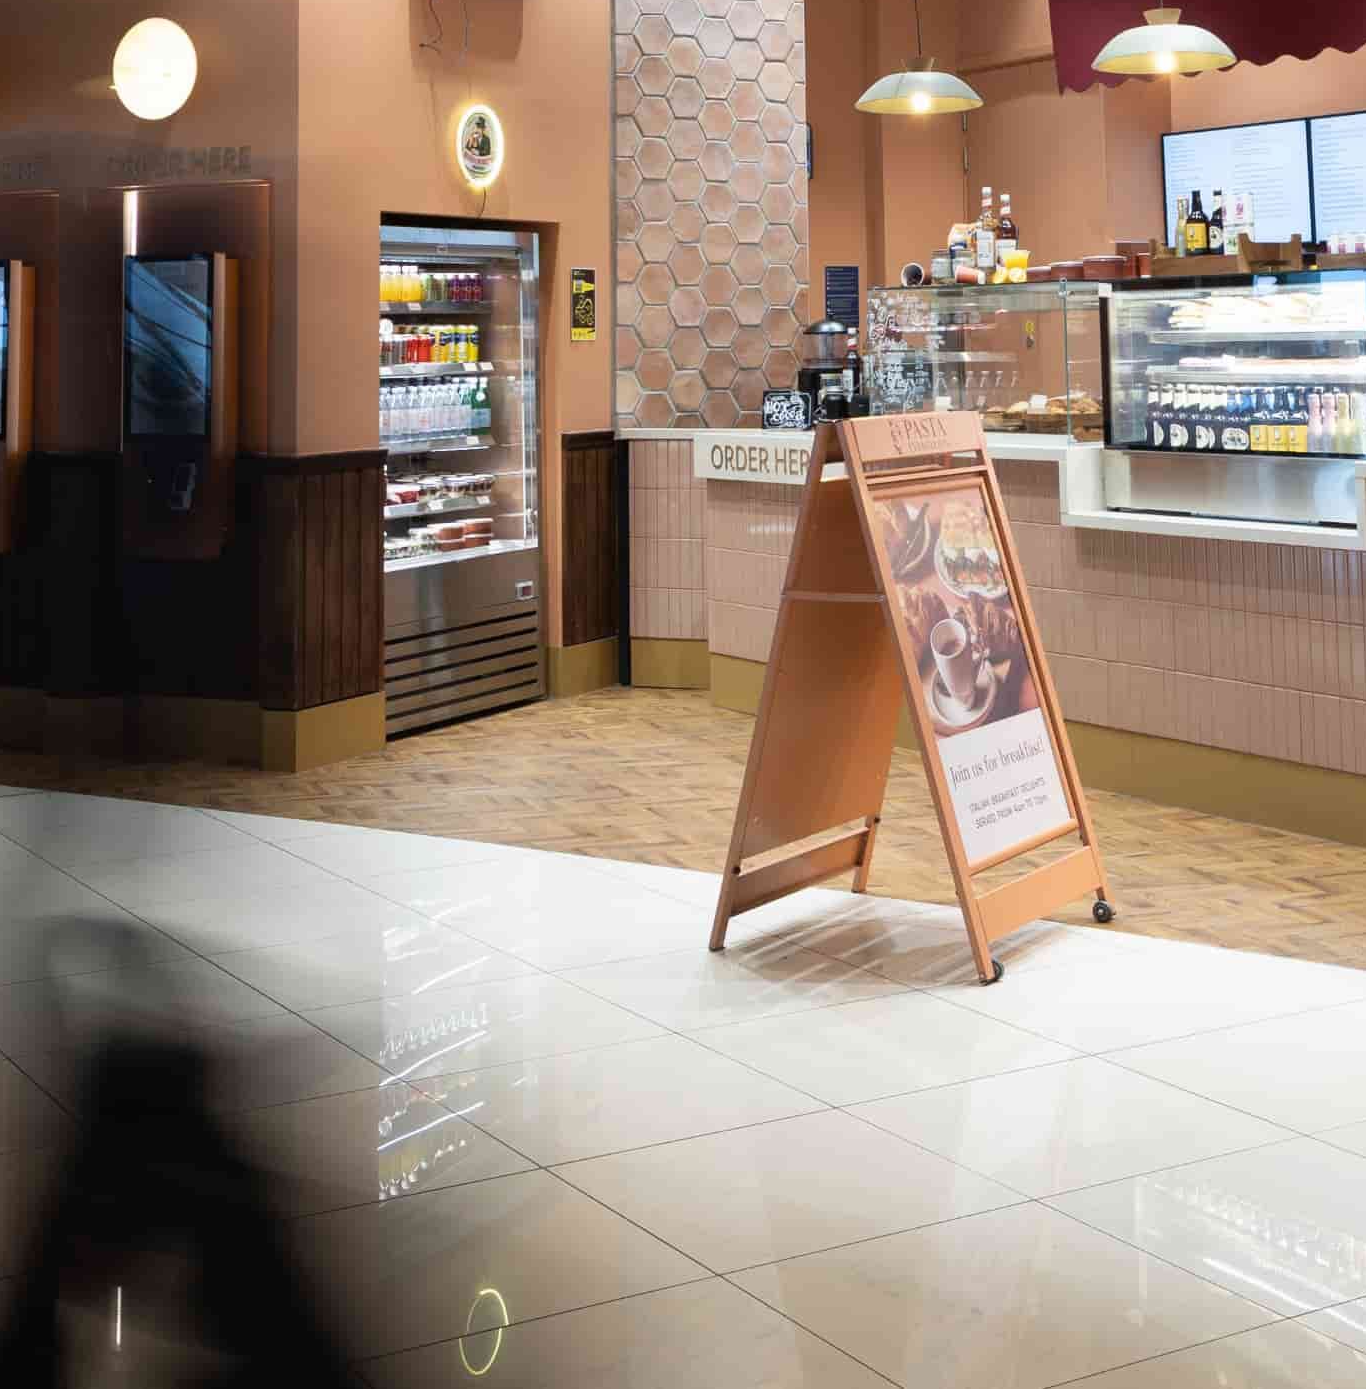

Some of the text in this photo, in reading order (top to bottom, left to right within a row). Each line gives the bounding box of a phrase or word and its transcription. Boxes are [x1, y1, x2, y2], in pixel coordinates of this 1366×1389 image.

[903, 417, 948, 437] PASTA
[711, 445, 811, 476] ORDER HER
[949, 762, 971, 790] Join
[984, 753, 999, 773] for
